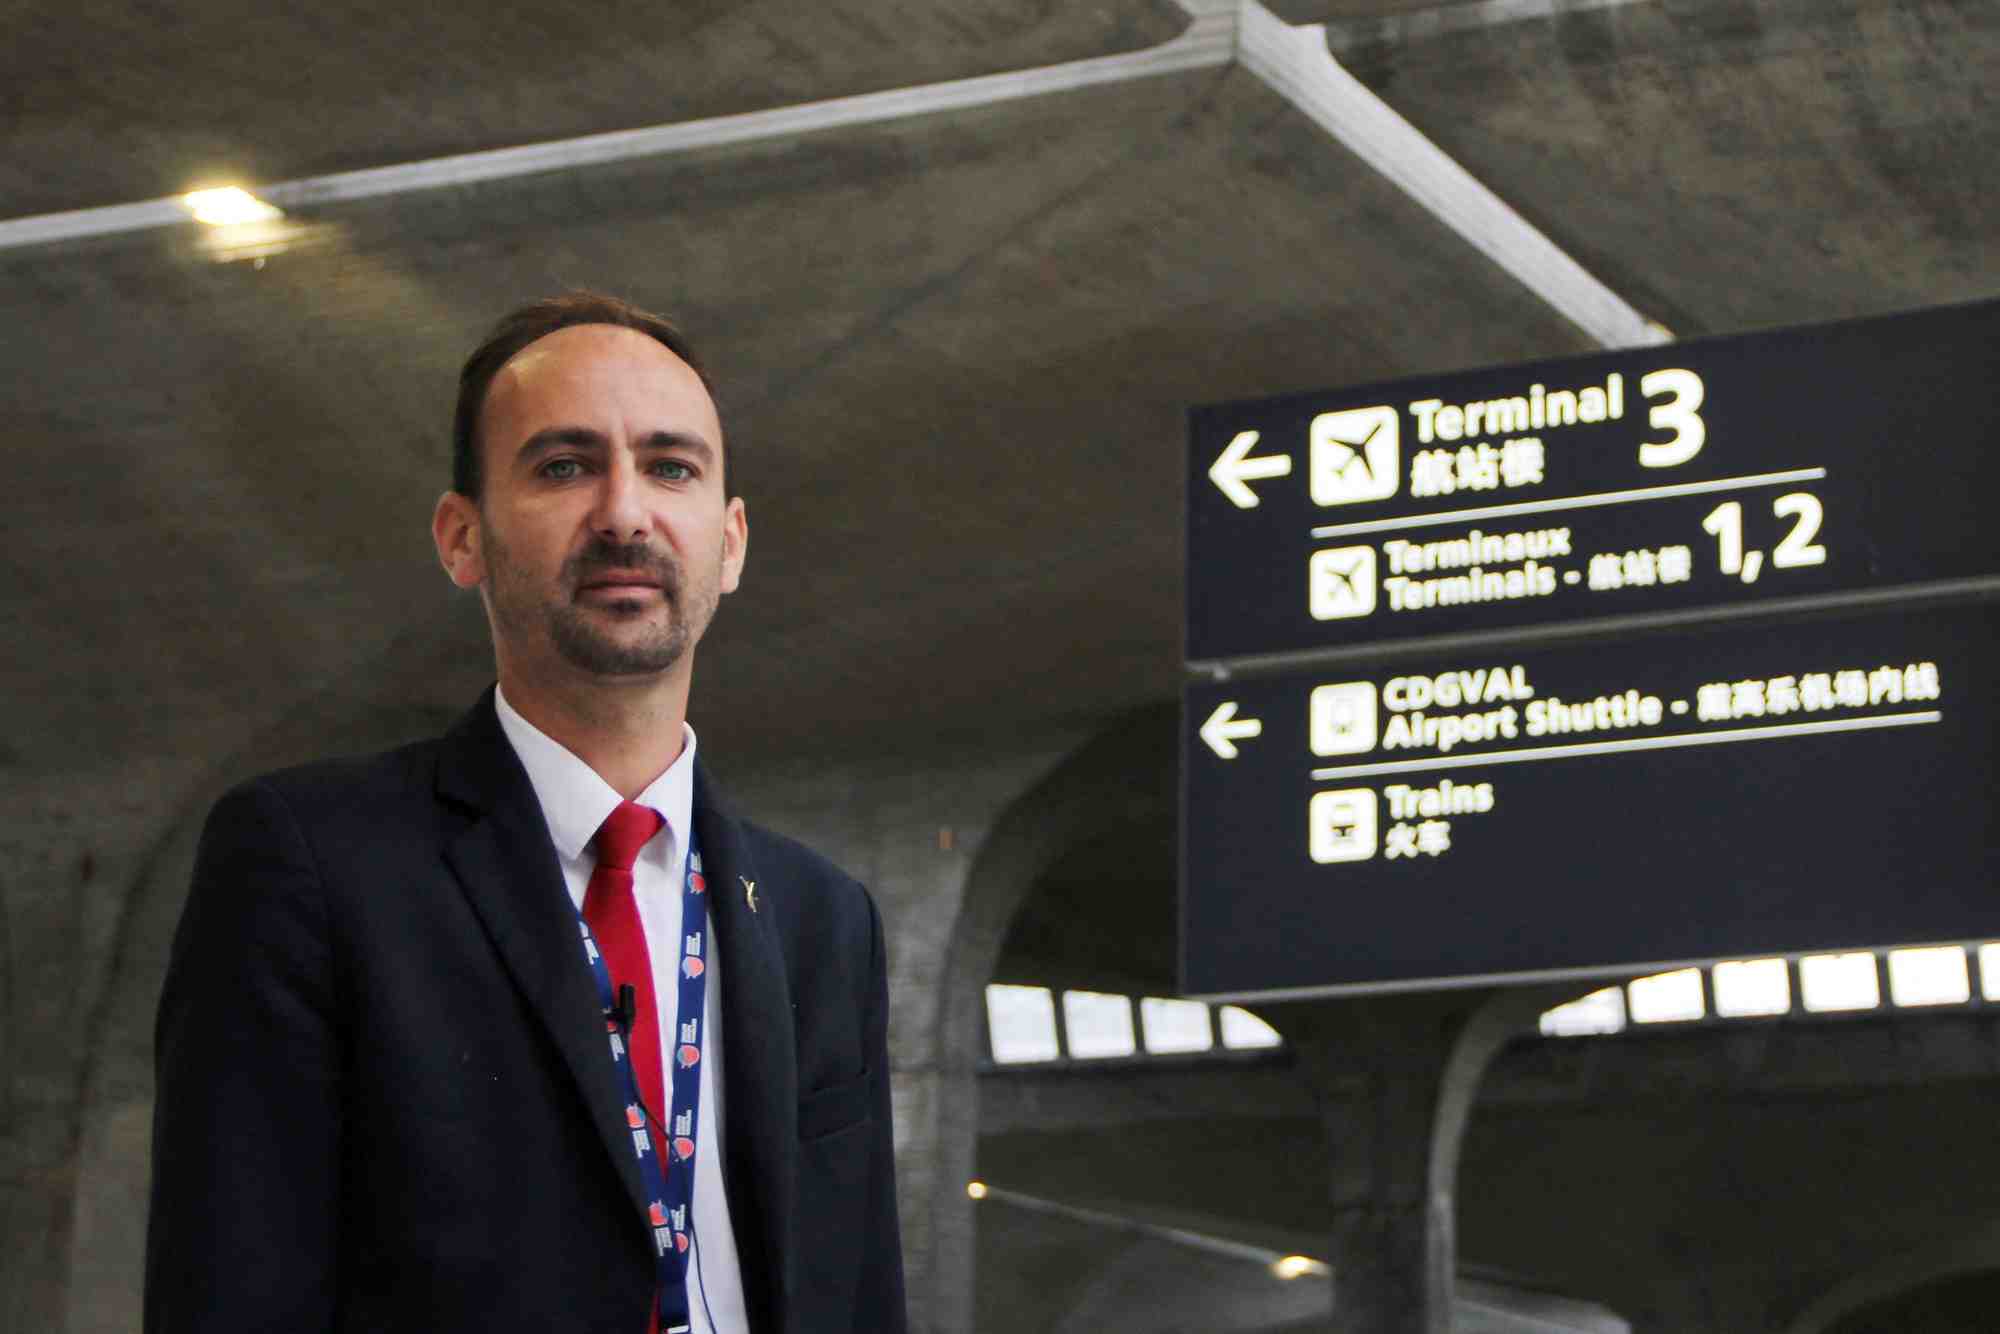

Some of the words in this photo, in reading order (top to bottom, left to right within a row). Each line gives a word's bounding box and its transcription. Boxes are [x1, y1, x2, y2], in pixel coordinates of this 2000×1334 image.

[1409, 372, 1624, 444] Terminal
[1638, 368, 1706, 468] 3
[1383, 528, 1572, 575] Terminaux
[1384, 559, 1557, 612] Terminals
[1383, 666, 1534, 712] CDGVAL
[1382, 706, 1519, 753] Airport
[1525, 690, 1664, 737] Shuttle
[1384, 779, 1495, 820] Trains
[1384, 819, 1451, 860] 火车
